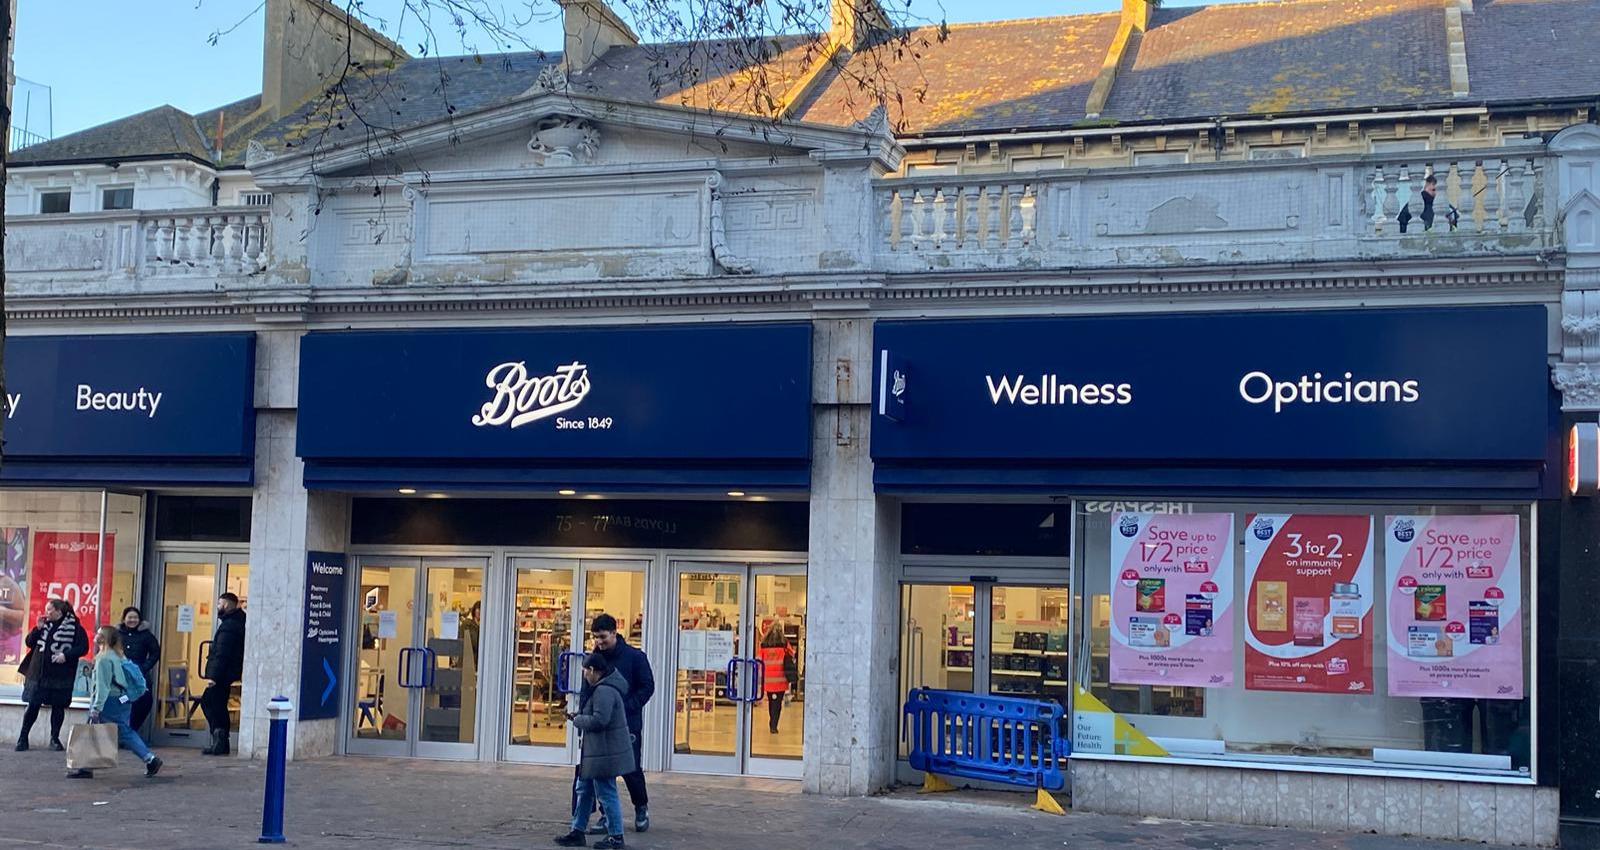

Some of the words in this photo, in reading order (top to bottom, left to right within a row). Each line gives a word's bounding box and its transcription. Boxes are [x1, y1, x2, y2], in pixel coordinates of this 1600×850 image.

[471, 361, 590, 428] Boots
[986, 374, 1132, 405] Wellness
[1239, 372, 1419, 413] Opticians
[76, 384, 162, 418] Beauty
[556, 418, 584, 429] Since
[588, 418, 612, 429] 1849
[556, 516, 572, 532] 75
[1149, 526, 1188, 540] Save
[1191, 533, 1204, 543] up
[1426, 530, 1469, 545] Save
[1473, 538, 1488, 546] up
[1490, 536, 1501, 544] to
[1140, 542, 1173, 562] 1/2
[1176, 544, 1208, 556] price
[1286, 534, 1302, 558] 3
[1306, 541, 1325, 556] for
[1327, 534, 1342, 558] 2
[1300, 559, 1342, 569] immunity
[1417, 546, 1454, 568] 1/2
[1457, 547, 1492, 562] price
[312, 562, 343, 575] Welcome
[1144, 564, 1161, 573] only
[1296, 568, 1331, 576] support
[1423, 571, 1442, 580] only
[1444, 570, 1464, 579] with
[47, 582, 98, 613] 50%
[80, 606, 98, 614] OF
